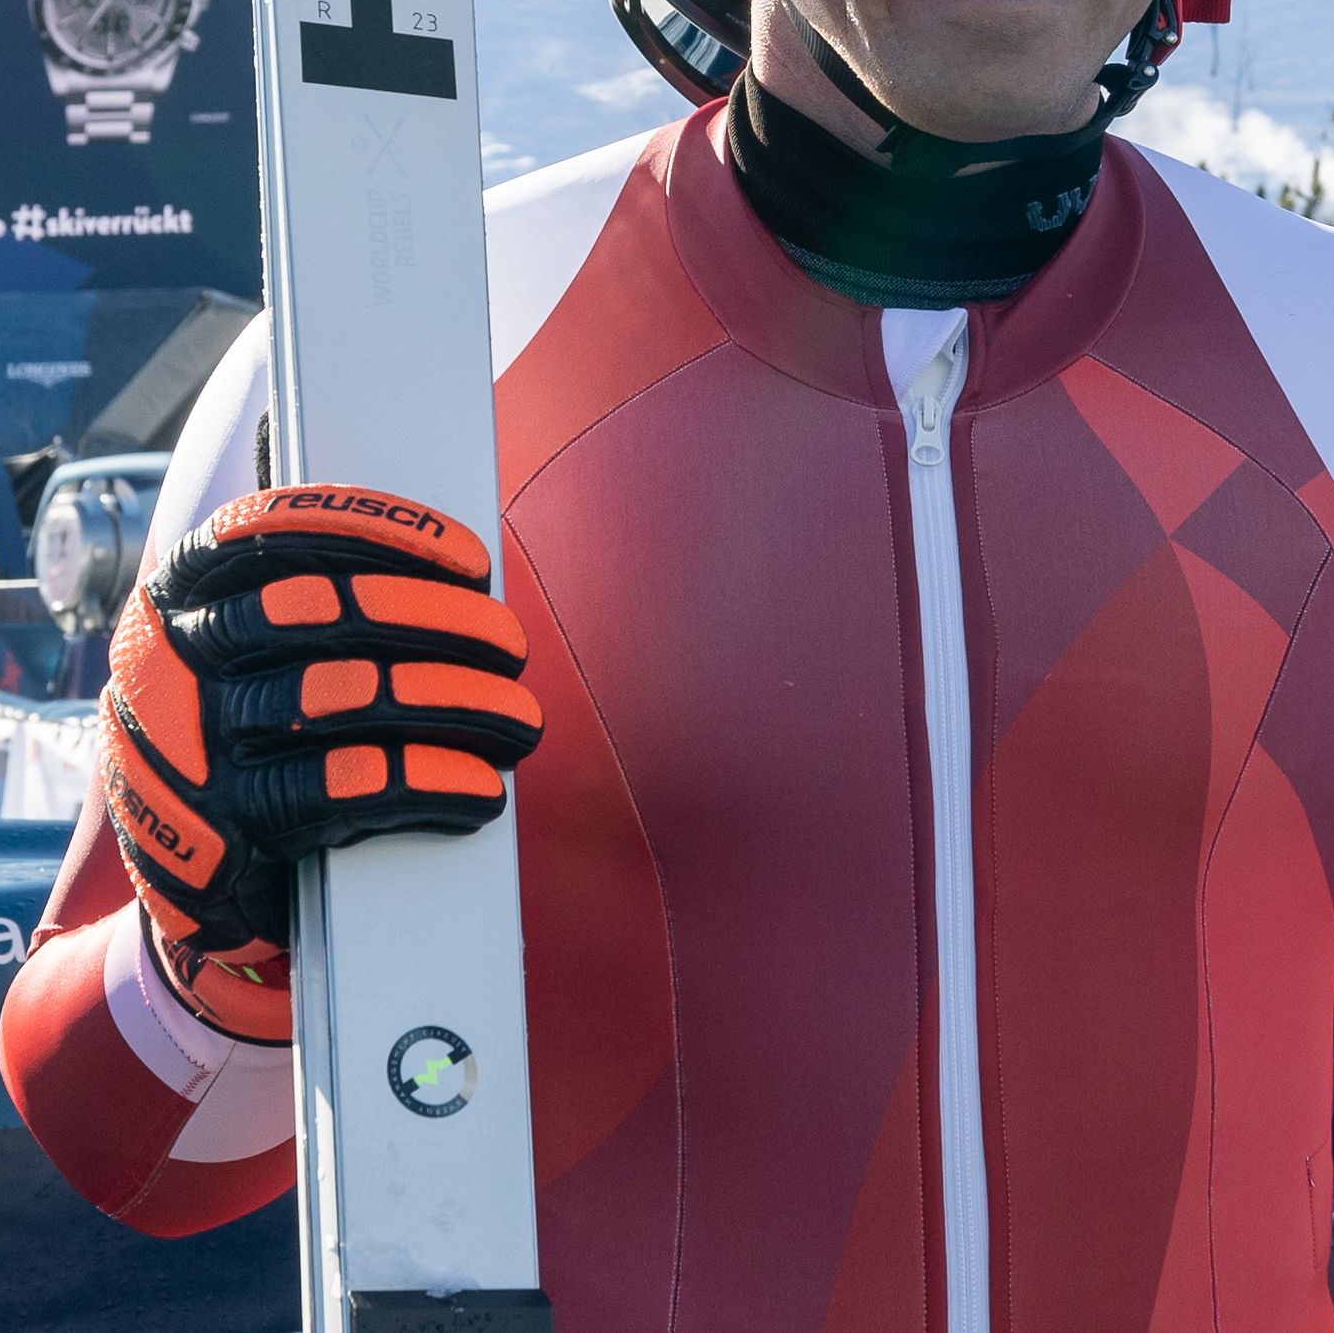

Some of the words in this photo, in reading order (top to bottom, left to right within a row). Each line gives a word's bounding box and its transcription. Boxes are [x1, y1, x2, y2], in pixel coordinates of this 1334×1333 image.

[318, 0, 332, 20] R
[412, 12, 439, 32] 23
[266, 491, 446, 539] reusch
